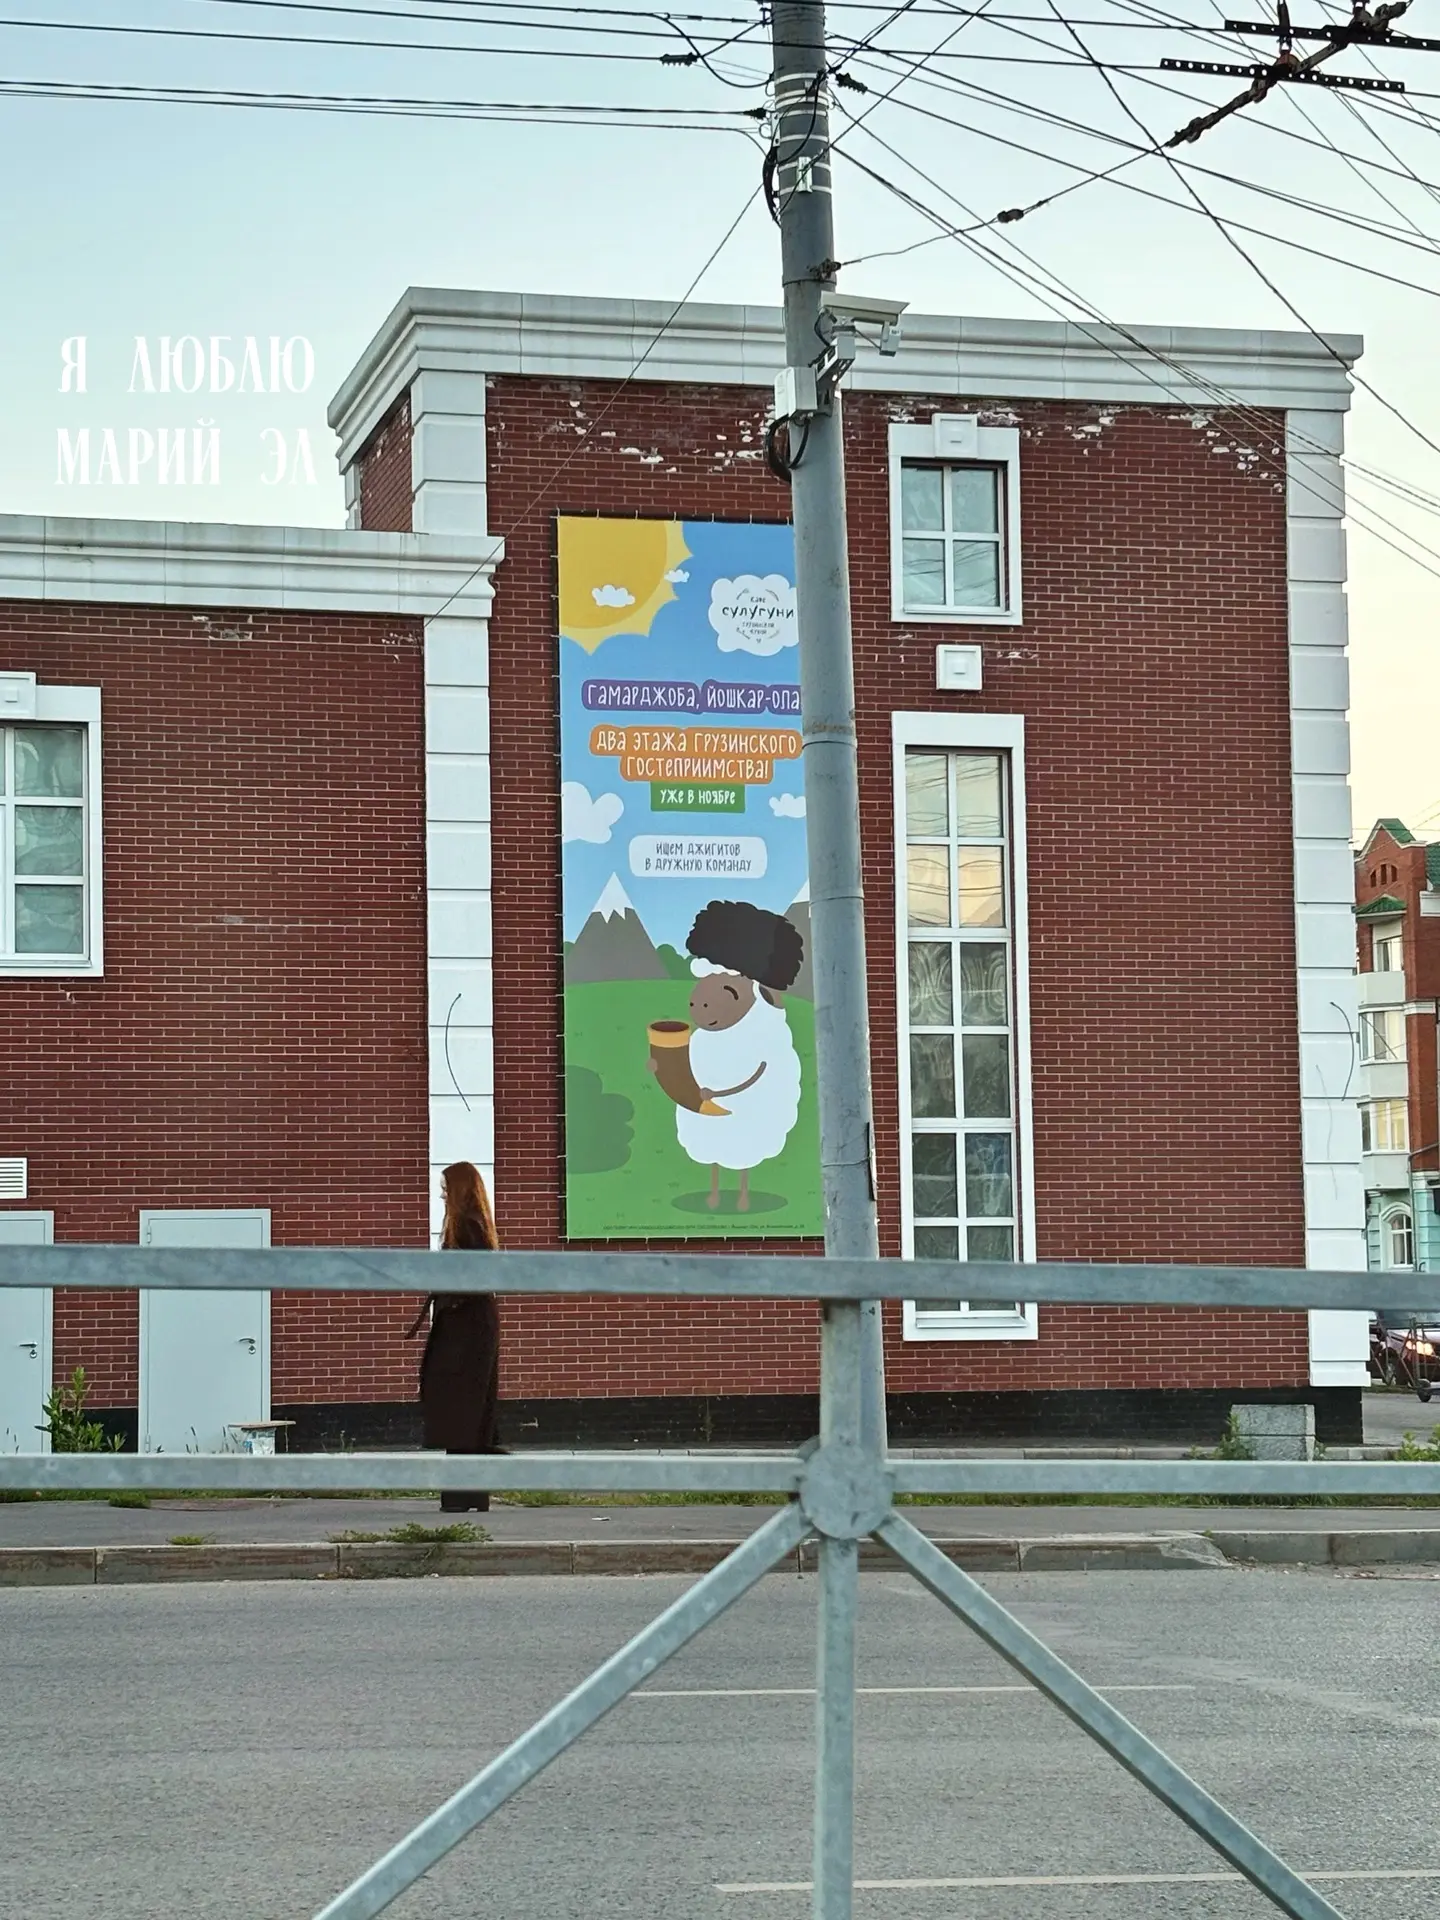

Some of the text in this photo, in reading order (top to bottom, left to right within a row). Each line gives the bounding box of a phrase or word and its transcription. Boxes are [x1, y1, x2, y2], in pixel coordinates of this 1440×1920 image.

[694, 733, 797, 754] ГРУЗИНСКОГО
[687, 789, 695, 804] В
[687, 843, 741, 857] ДЖИГИТОВ
[645, 858, 651, 871] В
[655, 858, 703, 872] ДРУЖНУЮ
